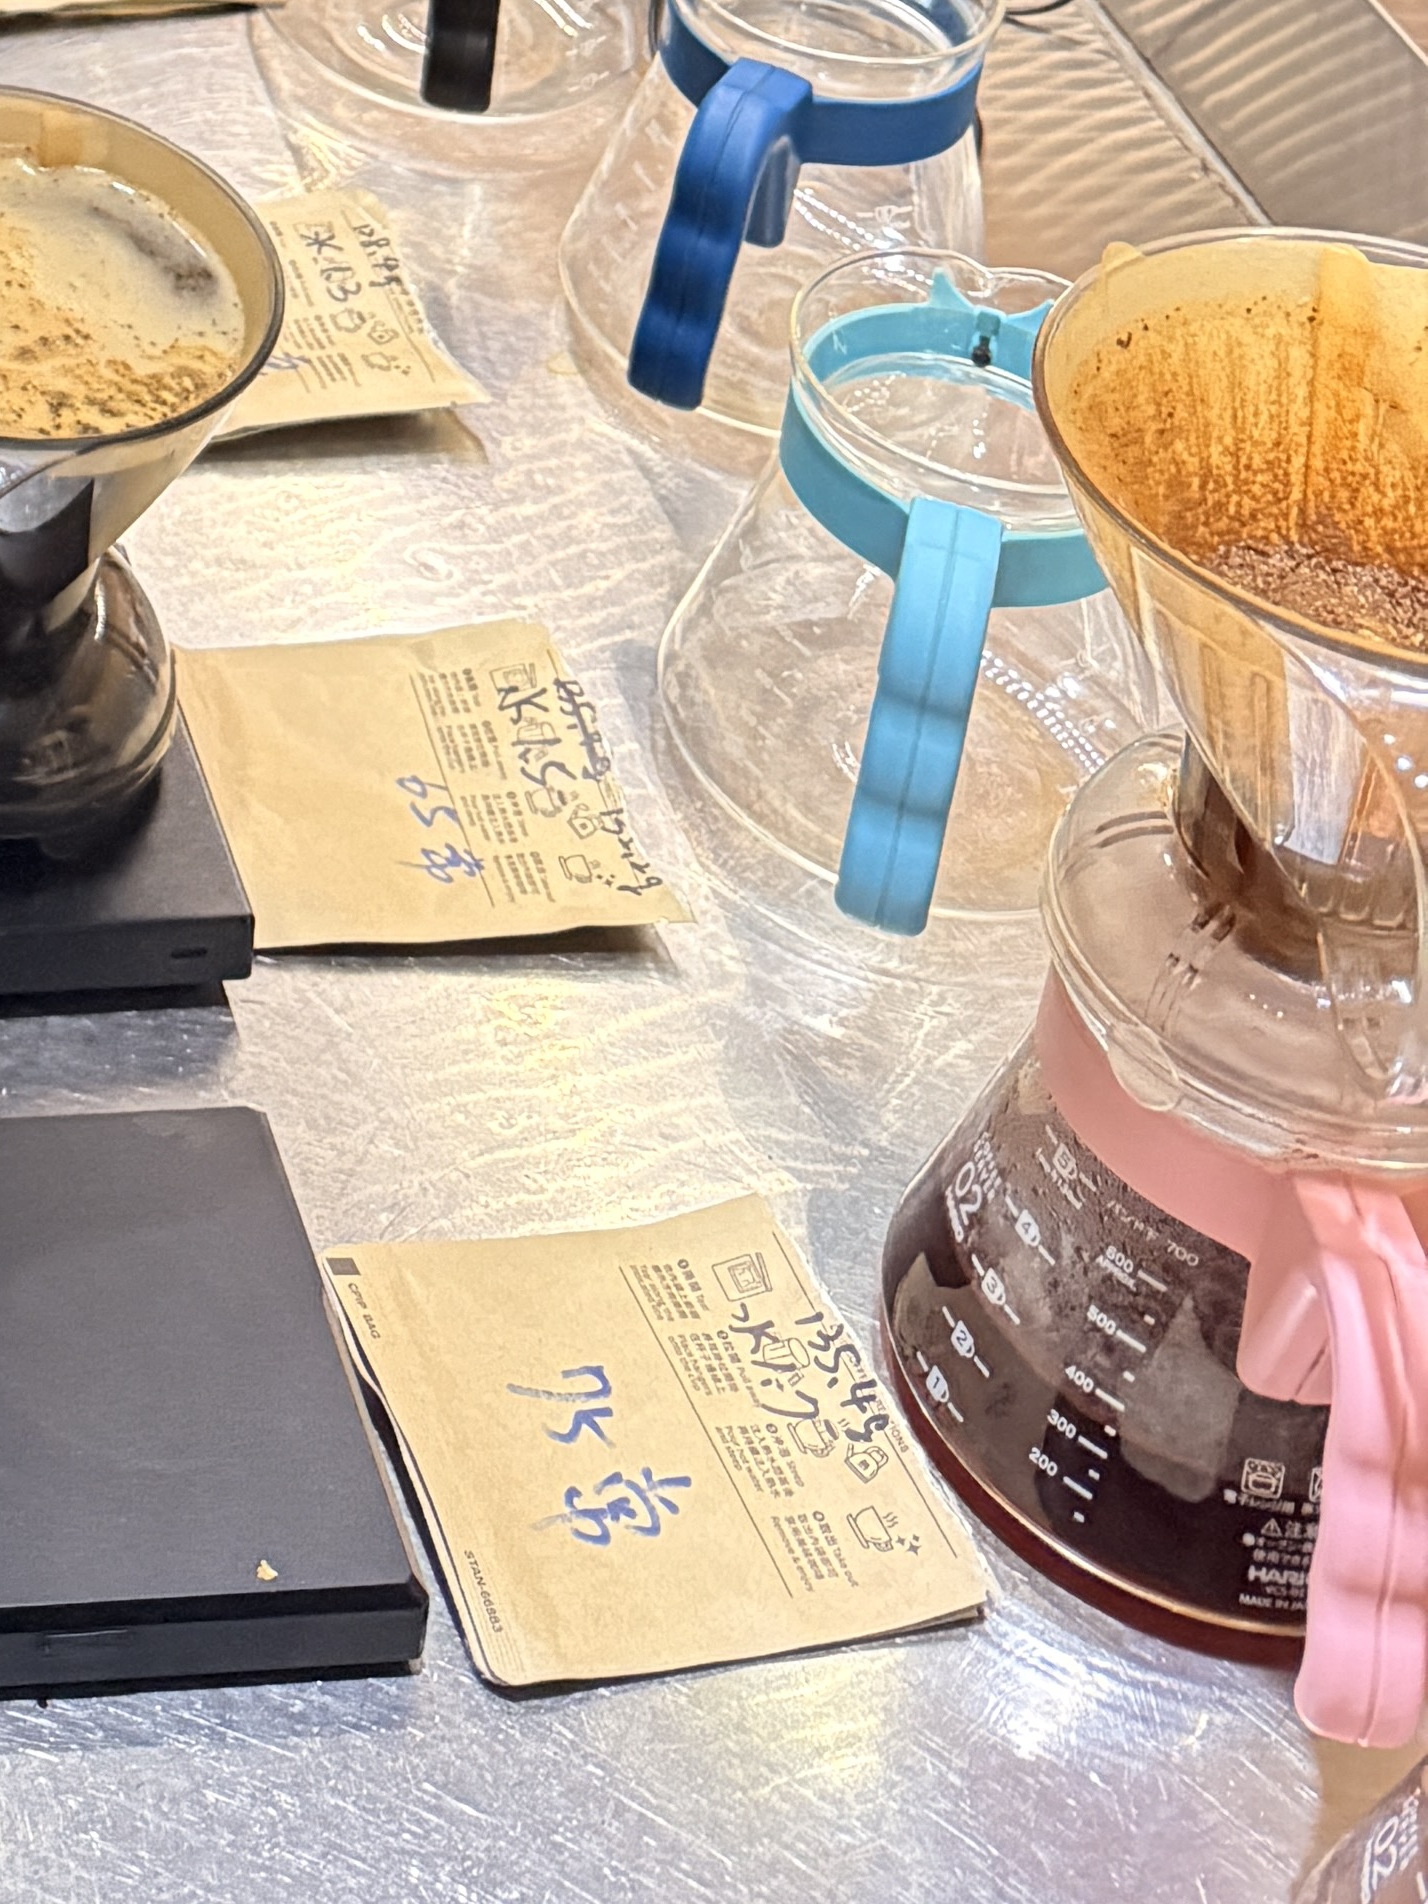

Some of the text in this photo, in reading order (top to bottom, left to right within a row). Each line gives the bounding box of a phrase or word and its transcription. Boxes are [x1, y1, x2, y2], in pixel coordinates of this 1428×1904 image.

[955, 1160, 983, 1226] 02
[1166, 1239, 1200, 1268] 700
[1087, 1303, 1117, 1336] 500
[1065, 1364, 1094, 1393] 400
[1047, 1408, 1077, 1439] 300
[1028, 1446, 1058, 1477] 200
[769, 1515, 797, 1555] Remove
[1248, 1564, 1309, 1586] HARI
[1238, 1592, 1273, 1608] MADE
